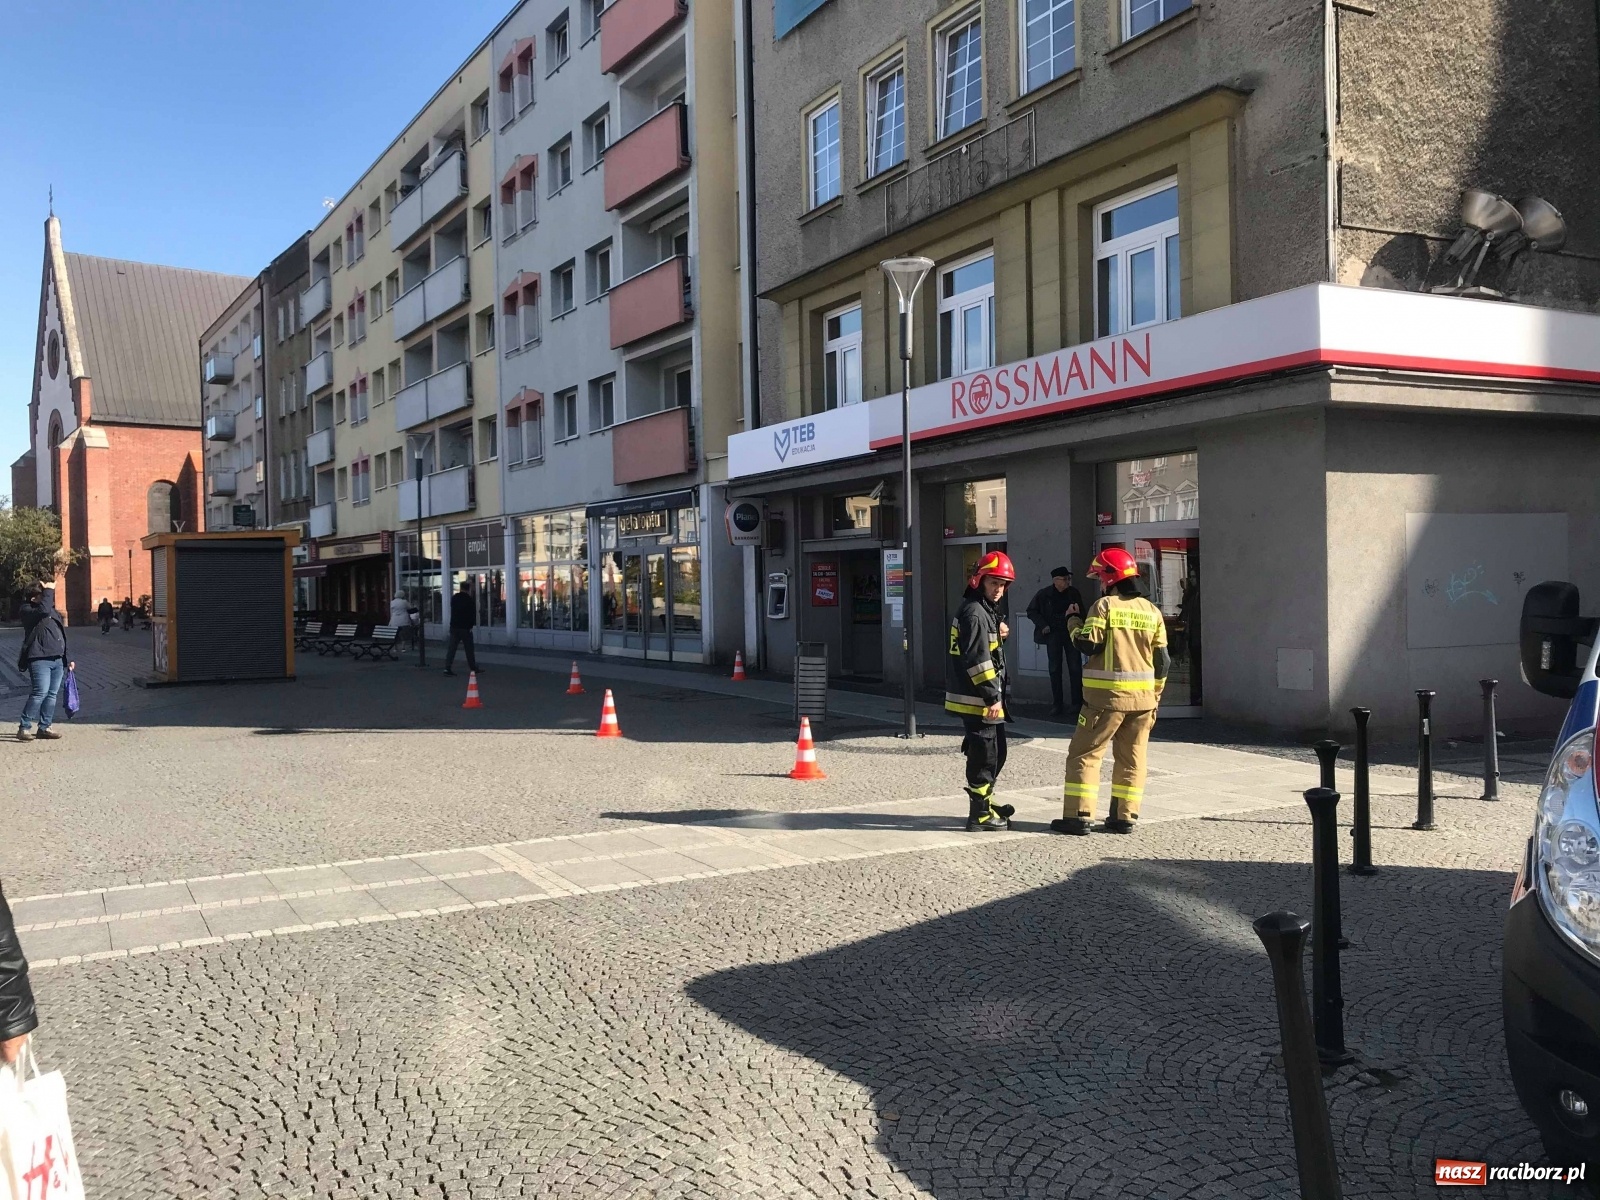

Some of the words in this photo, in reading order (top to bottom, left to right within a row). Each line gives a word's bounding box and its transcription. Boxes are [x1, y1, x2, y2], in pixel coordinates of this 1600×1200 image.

[951, 332, 1151, 419] ROSSMANN
[791, 422, 815, 444] TEB
[791, 444, 816, 456] EDUKACJA
[467, 534, 487, 555] empik
